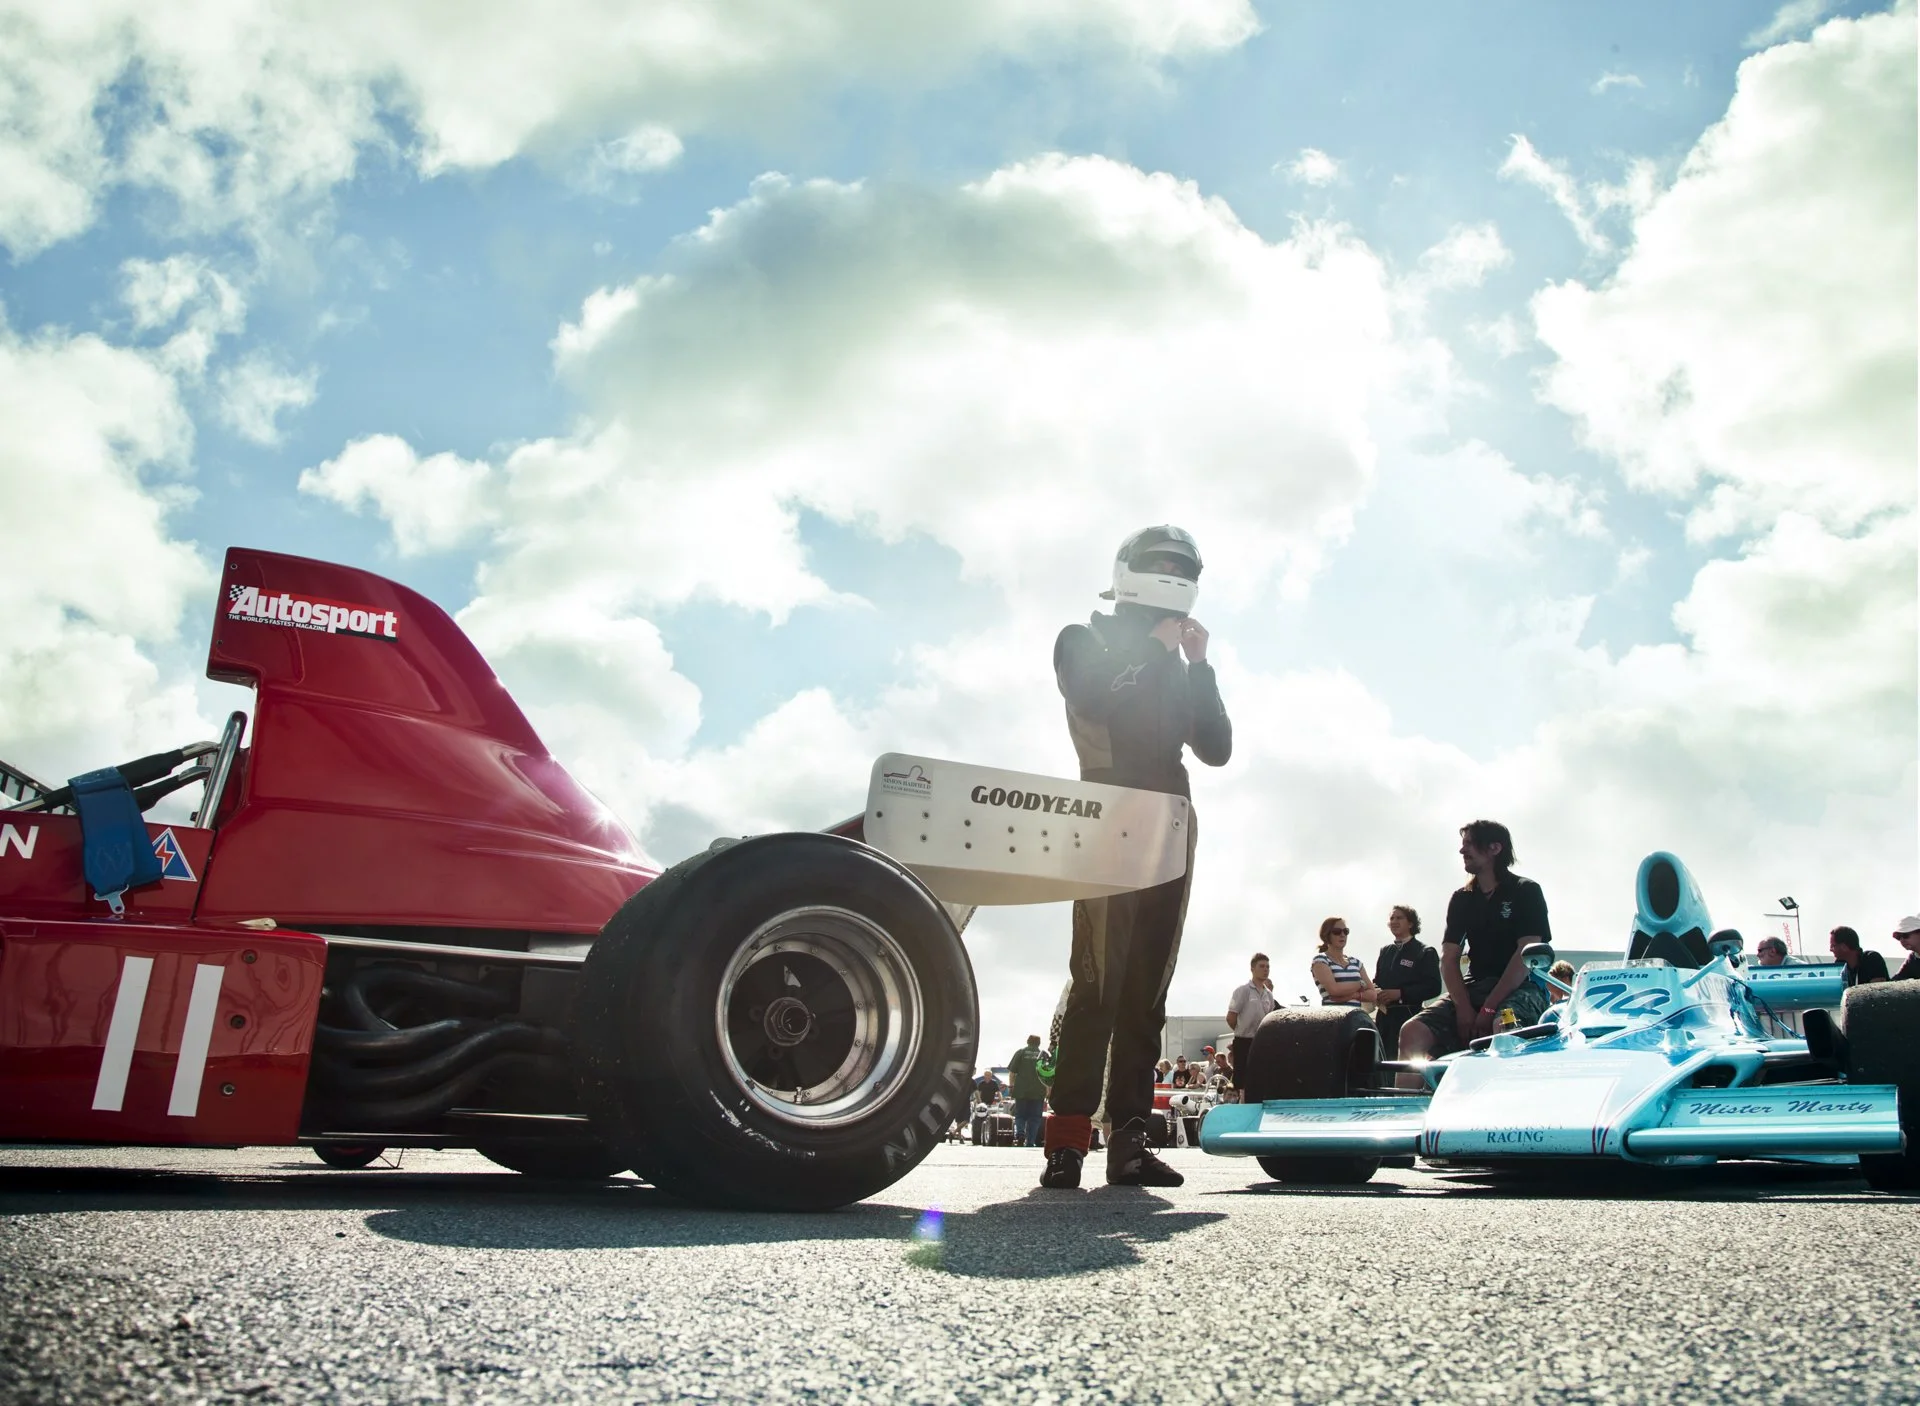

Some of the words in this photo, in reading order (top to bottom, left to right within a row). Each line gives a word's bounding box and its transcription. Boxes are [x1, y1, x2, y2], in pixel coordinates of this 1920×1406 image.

[228, 613, 241, 621] THE
[241, 615, 269, 624] WORLD'S
[269, 619, 295, 627] FASTEST
[295, 622, 327, 632] MAGAZINE
[229, 585, 397, 637] Autosport
[971, 785, 1103, 820] GOODYEAR
[0, 823, 39, 859] N
[1589, 971, 1650, 982] GOODYEAR
[91, 955, 225, 1117] 11
[1690, 1102, 1774, 1115] Mister
[1788, 1100, 1873, 1114] Marty
[1487, 1130, 1544, 1144] RACING
